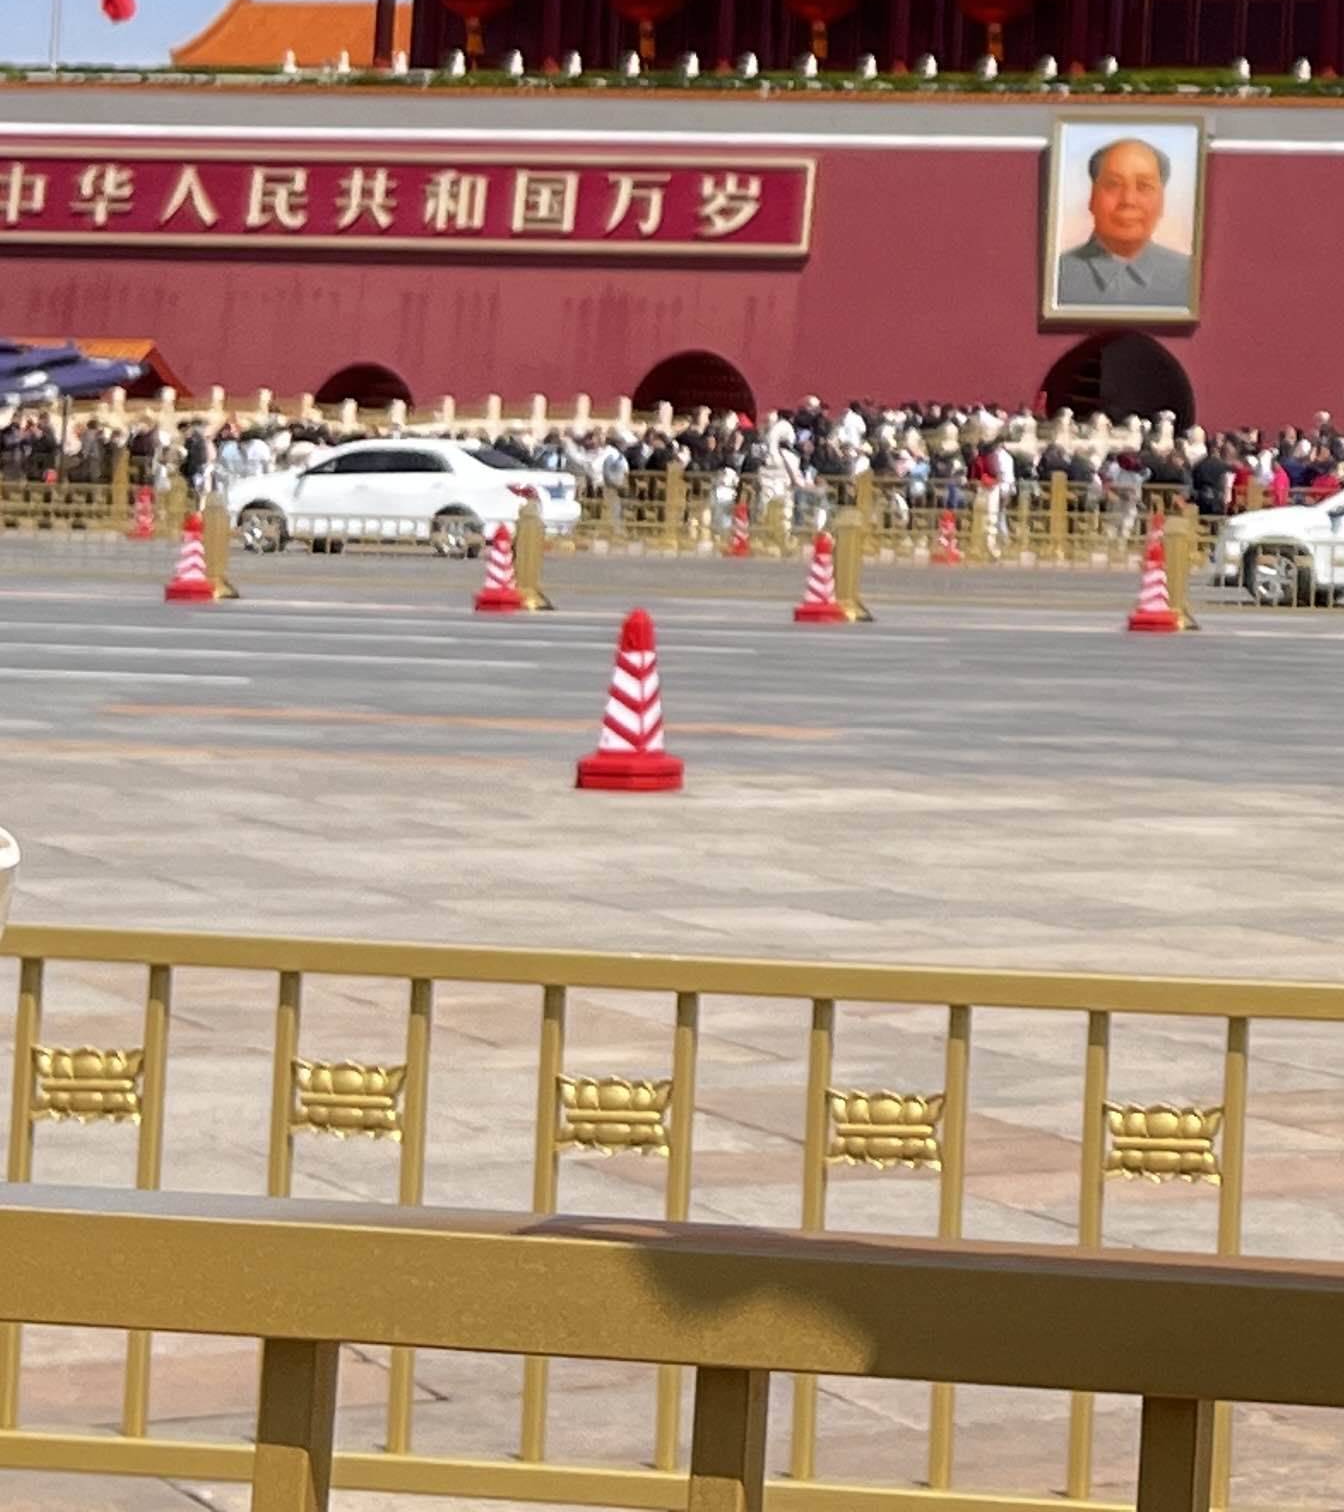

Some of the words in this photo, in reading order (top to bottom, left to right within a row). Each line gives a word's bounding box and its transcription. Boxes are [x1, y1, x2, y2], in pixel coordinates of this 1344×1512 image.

[0, 162, 763, 236] 中华人民共和国万岁
